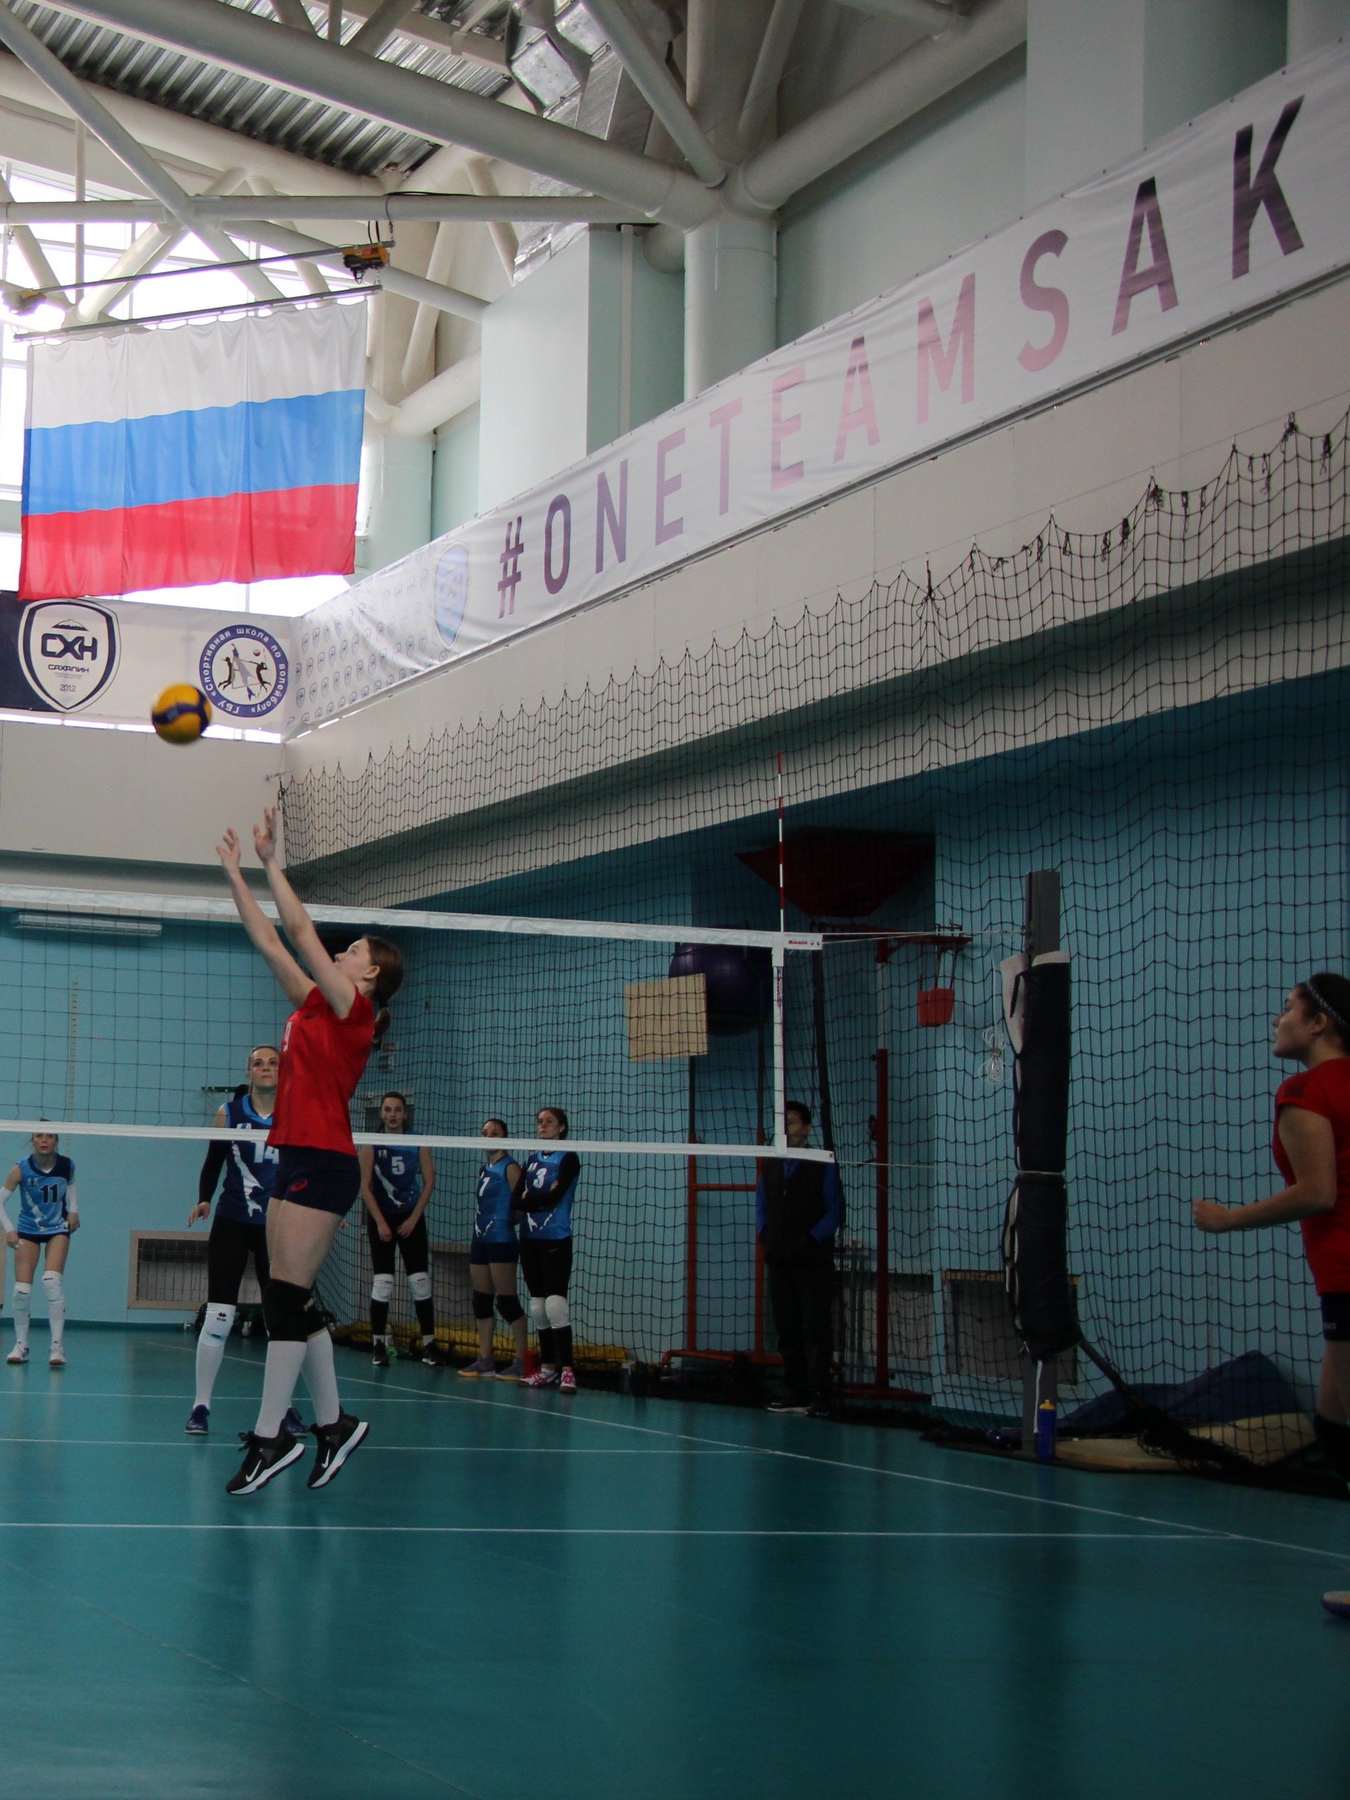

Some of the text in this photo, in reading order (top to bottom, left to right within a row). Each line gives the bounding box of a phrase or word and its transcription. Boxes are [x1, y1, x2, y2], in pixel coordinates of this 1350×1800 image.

[59, 684, 77, 692] 2012
[217, 700, 240, 714] ГБУ
[271, 644, 281, 658] по
[391, 1156, 405, 1175] 5
[533, 1168, 547, 1189] 3
[40, 1184, 58, 1204] 11
